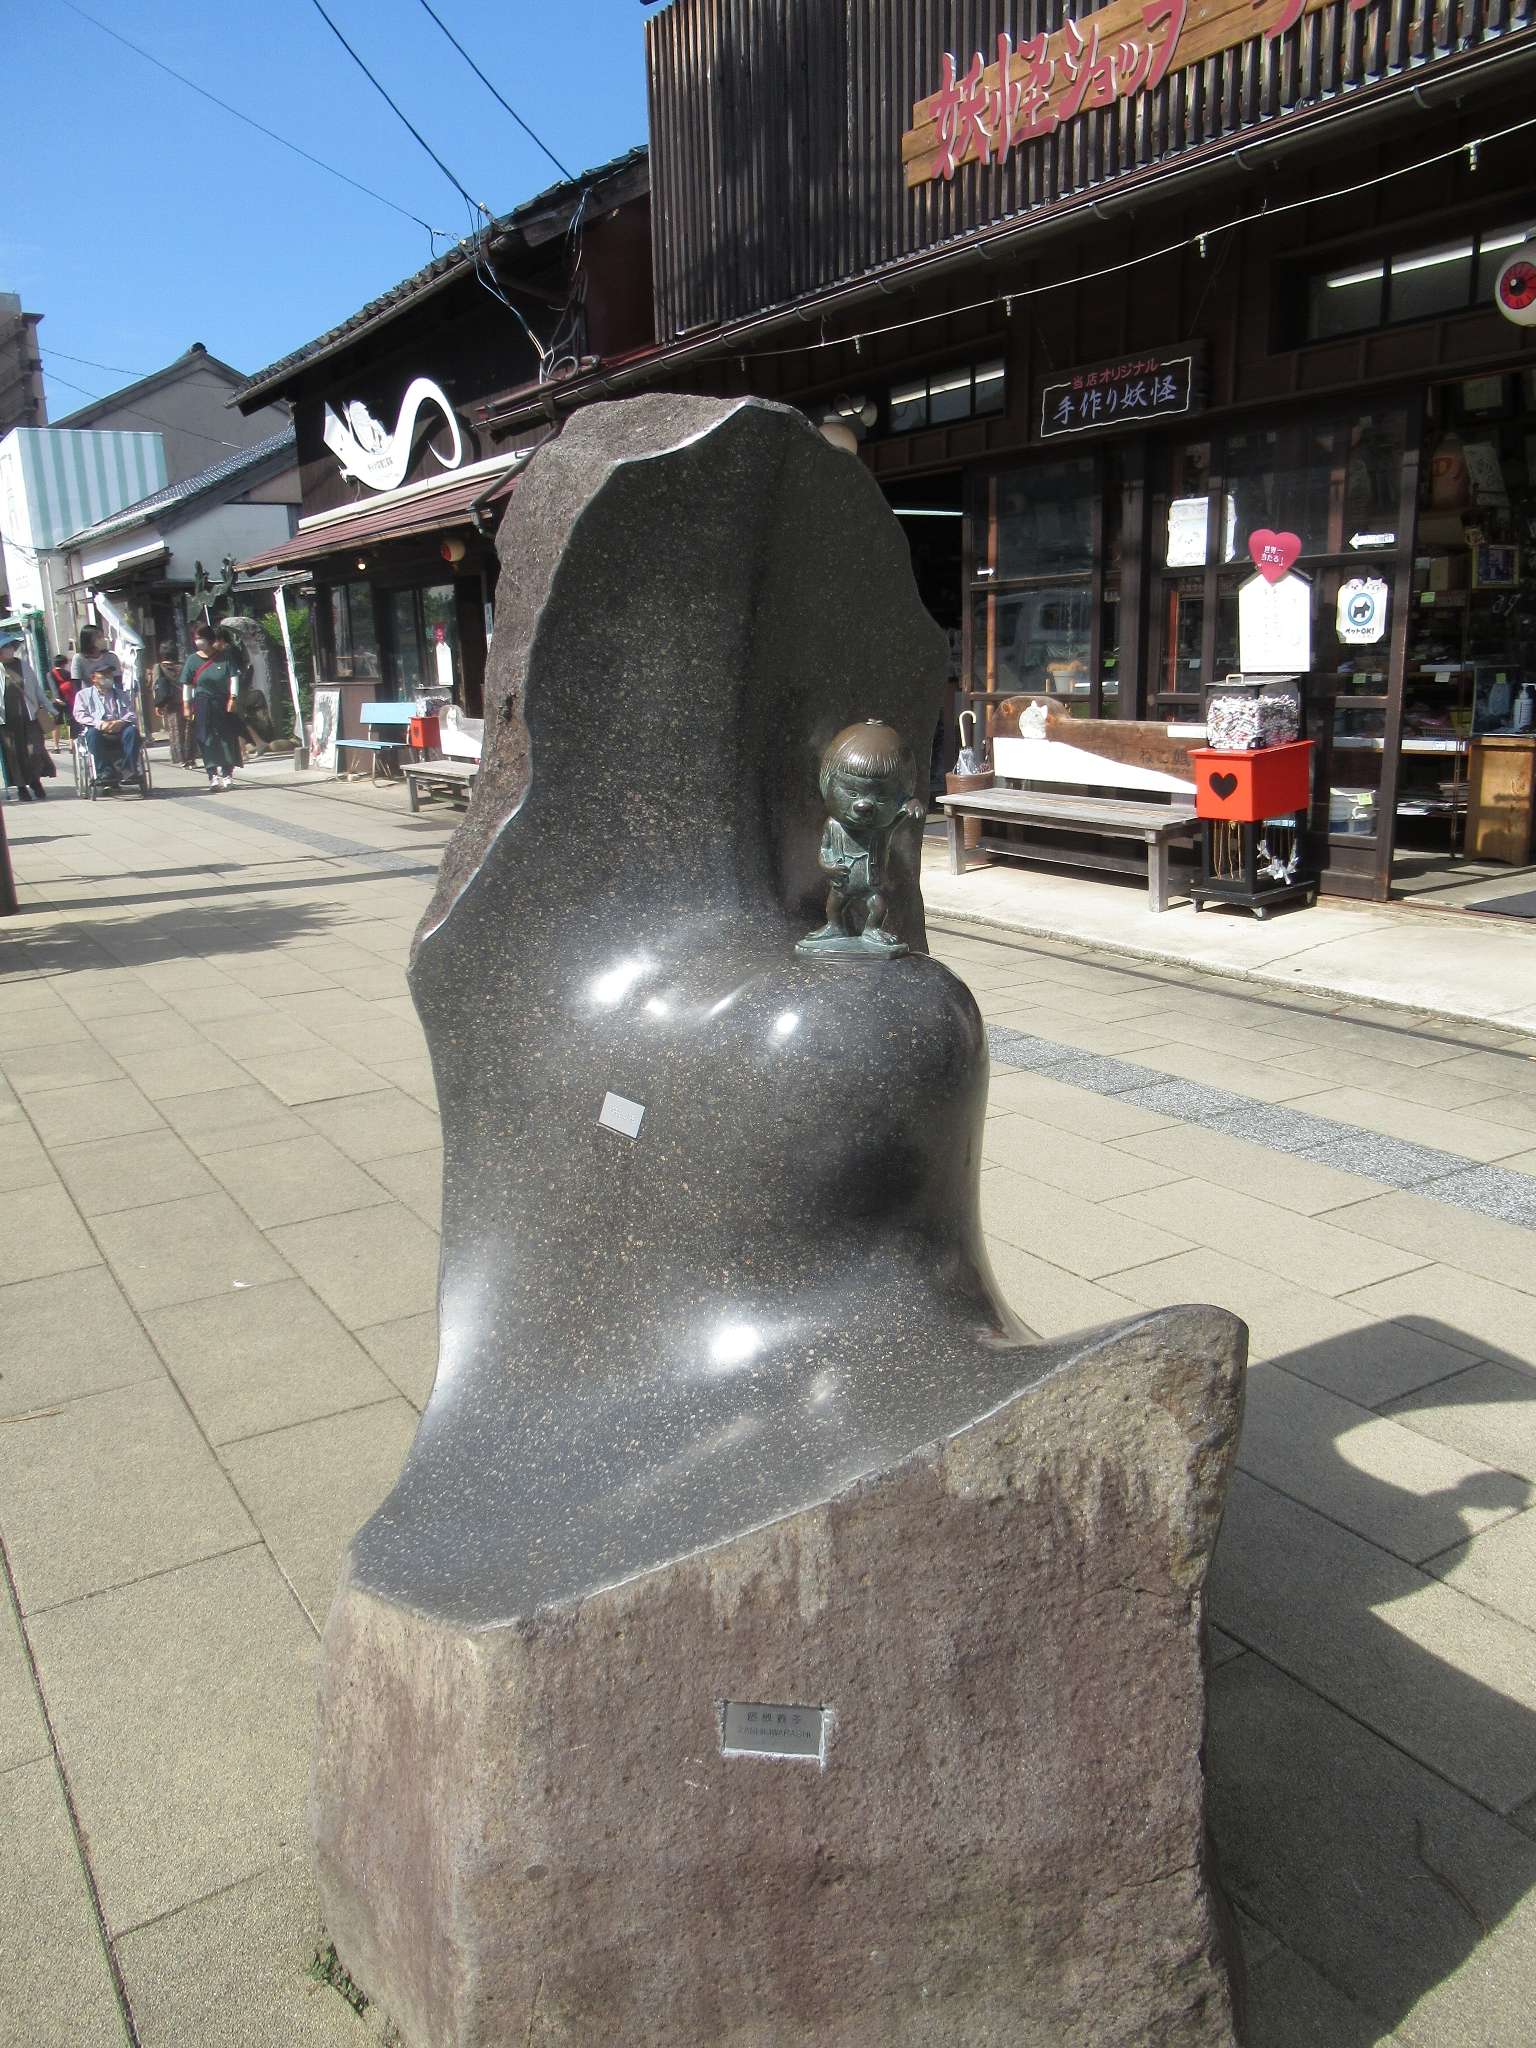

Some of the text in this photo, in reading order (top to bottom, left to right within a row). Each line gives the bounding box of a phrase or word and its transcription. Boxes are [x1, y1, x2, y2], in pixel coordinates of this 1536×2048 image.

[1072, 357, 1160, 390] 当店オリジナル
[1053, 374, 1177, 425] 手作り妖怪
